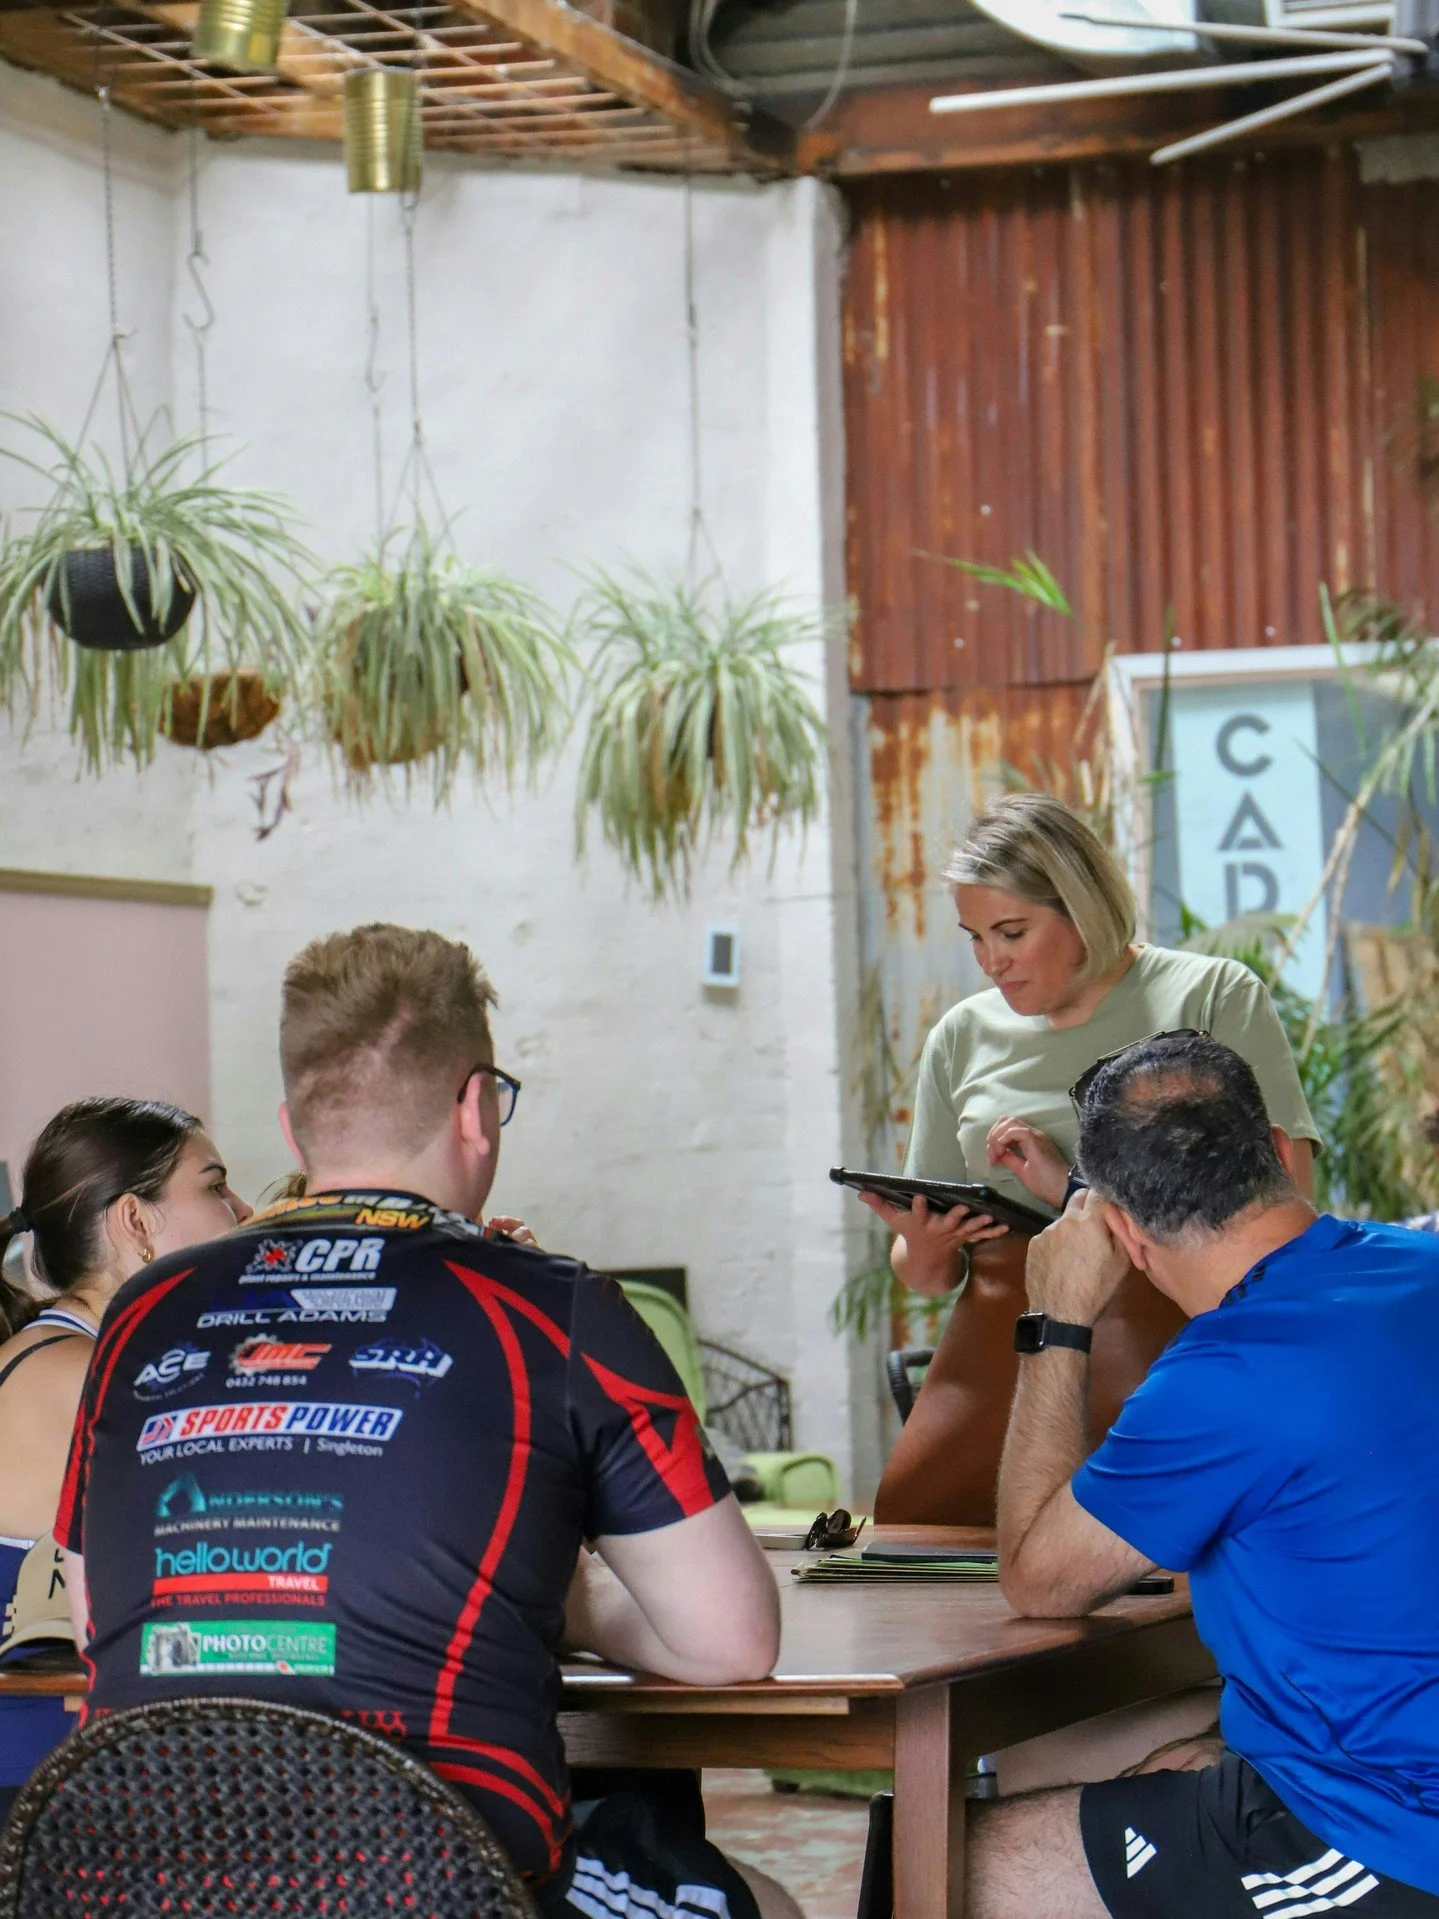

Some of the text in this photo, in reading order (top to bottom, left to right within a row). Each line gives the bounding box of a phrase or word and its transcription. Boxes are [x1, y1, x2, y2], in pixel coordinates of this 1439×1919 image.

[355, 1208, 430, 1229] NSW
[294, 1237, 385, 1273] CPR
[197, 1309, 387, 1328] DRILL ADAMS
[139, 1446, 175, 1467] YOUR
[176, 1440, 225, 1457] LOCAL
[227, 1436, 294, 1452] EXPERTS
[153, 1516, 341, 1537] MACHINERY MAINTENANCE
[154, 1540, 333, 1578] helloworld
[267, 1575, 321, 1591] TRAVEL
[151, 1592, 326, 1608] THE TRAVEL PROFESSIONALS
